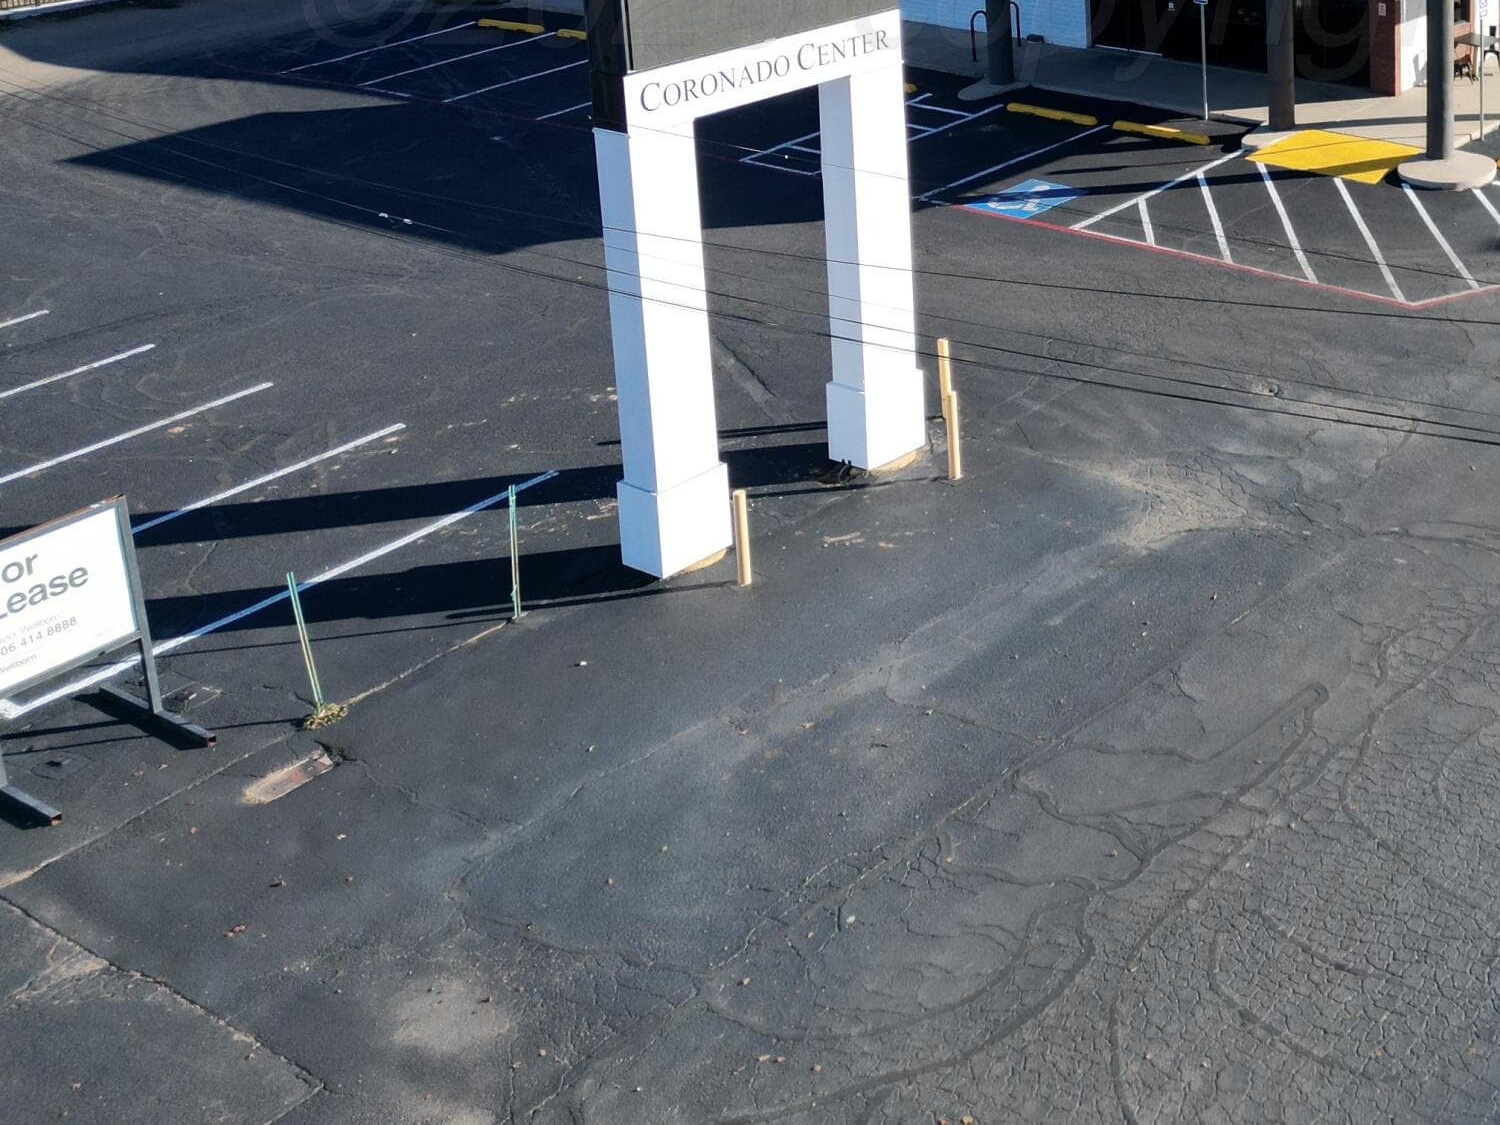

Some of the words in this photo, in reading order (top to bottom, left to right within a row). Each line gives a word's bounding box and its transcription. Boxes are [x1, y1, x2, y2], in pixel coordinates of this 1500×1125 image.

[640, 55, 790, 112] CORONADO
[797, 29, 889, 72] CENTER
[20, 631, 43, 646] 414
